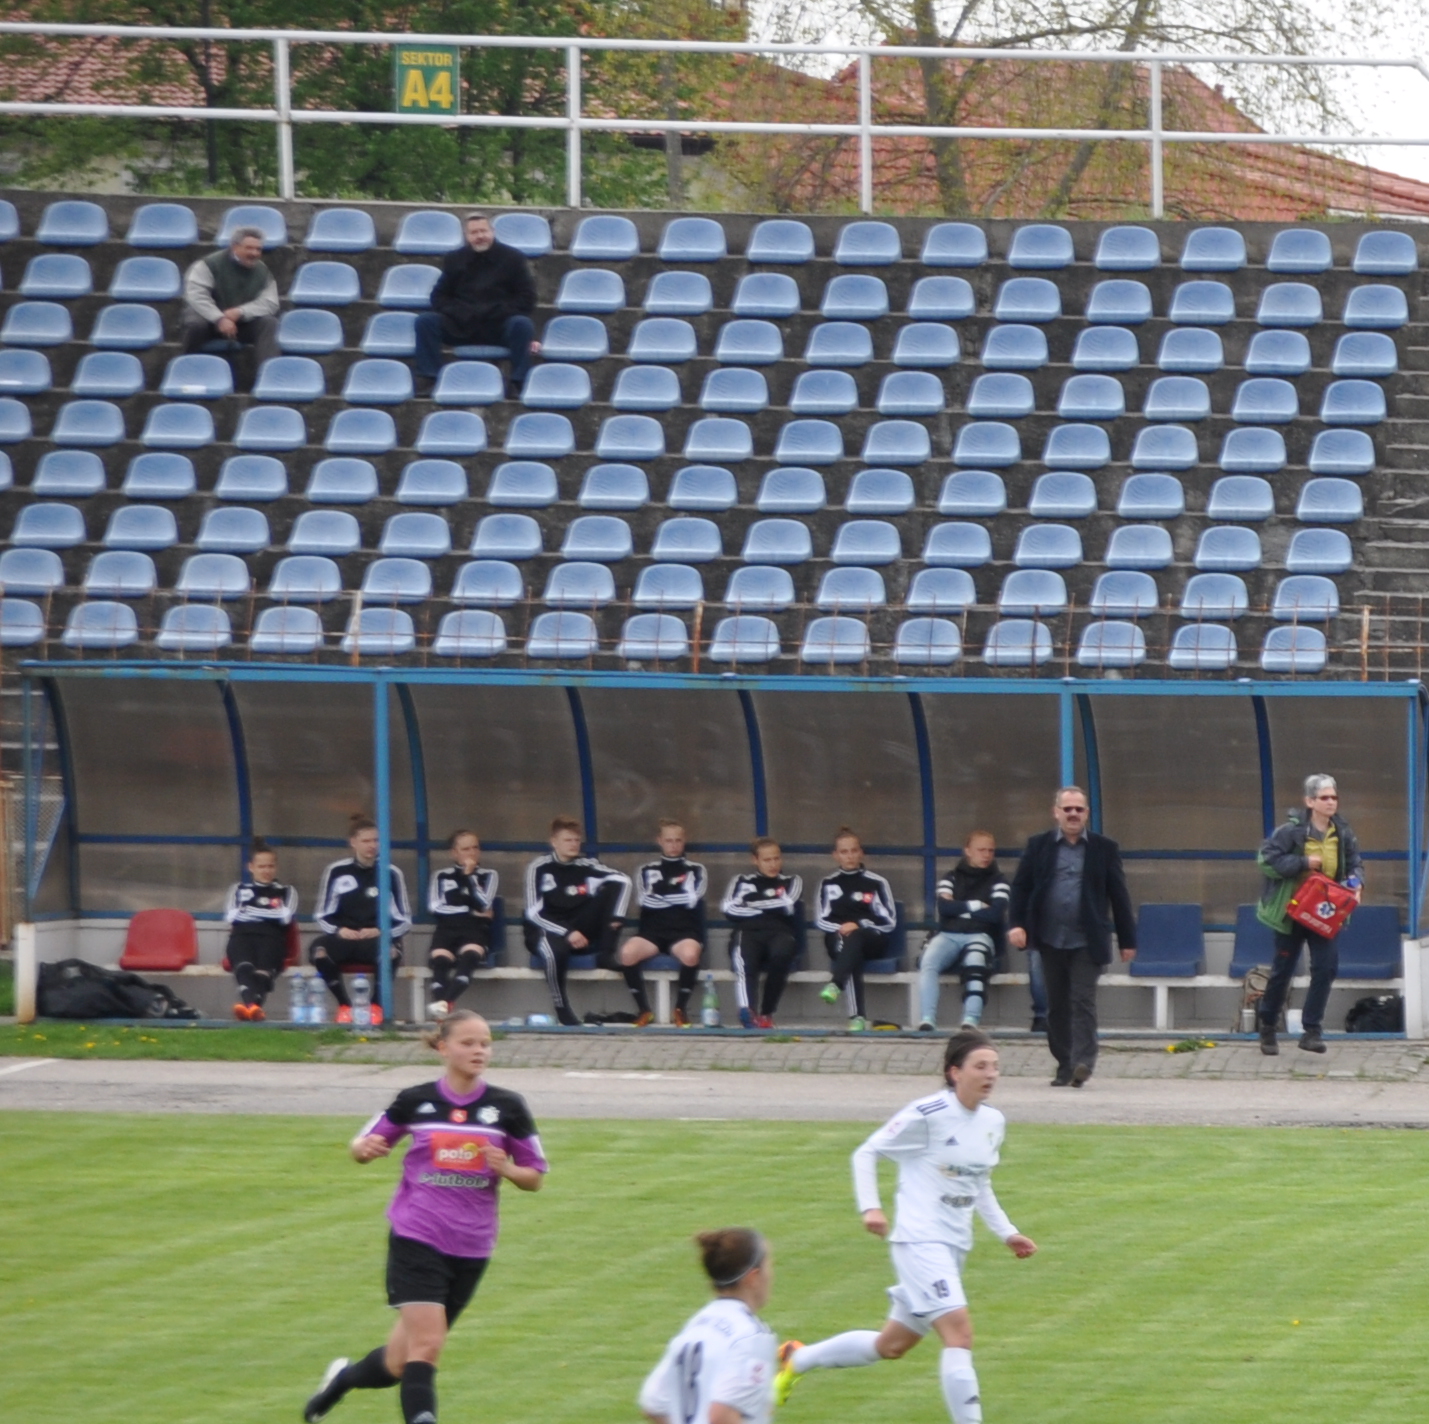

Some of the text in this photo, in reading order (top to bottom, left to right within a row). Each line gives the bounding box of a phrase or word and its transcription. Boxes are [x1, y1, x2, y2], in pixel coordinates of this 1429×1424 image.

[401, 51, 453, 67] SEKTOR
[401, 69, 454, 109] A4
[438, 1147, 474, 1161] polo
